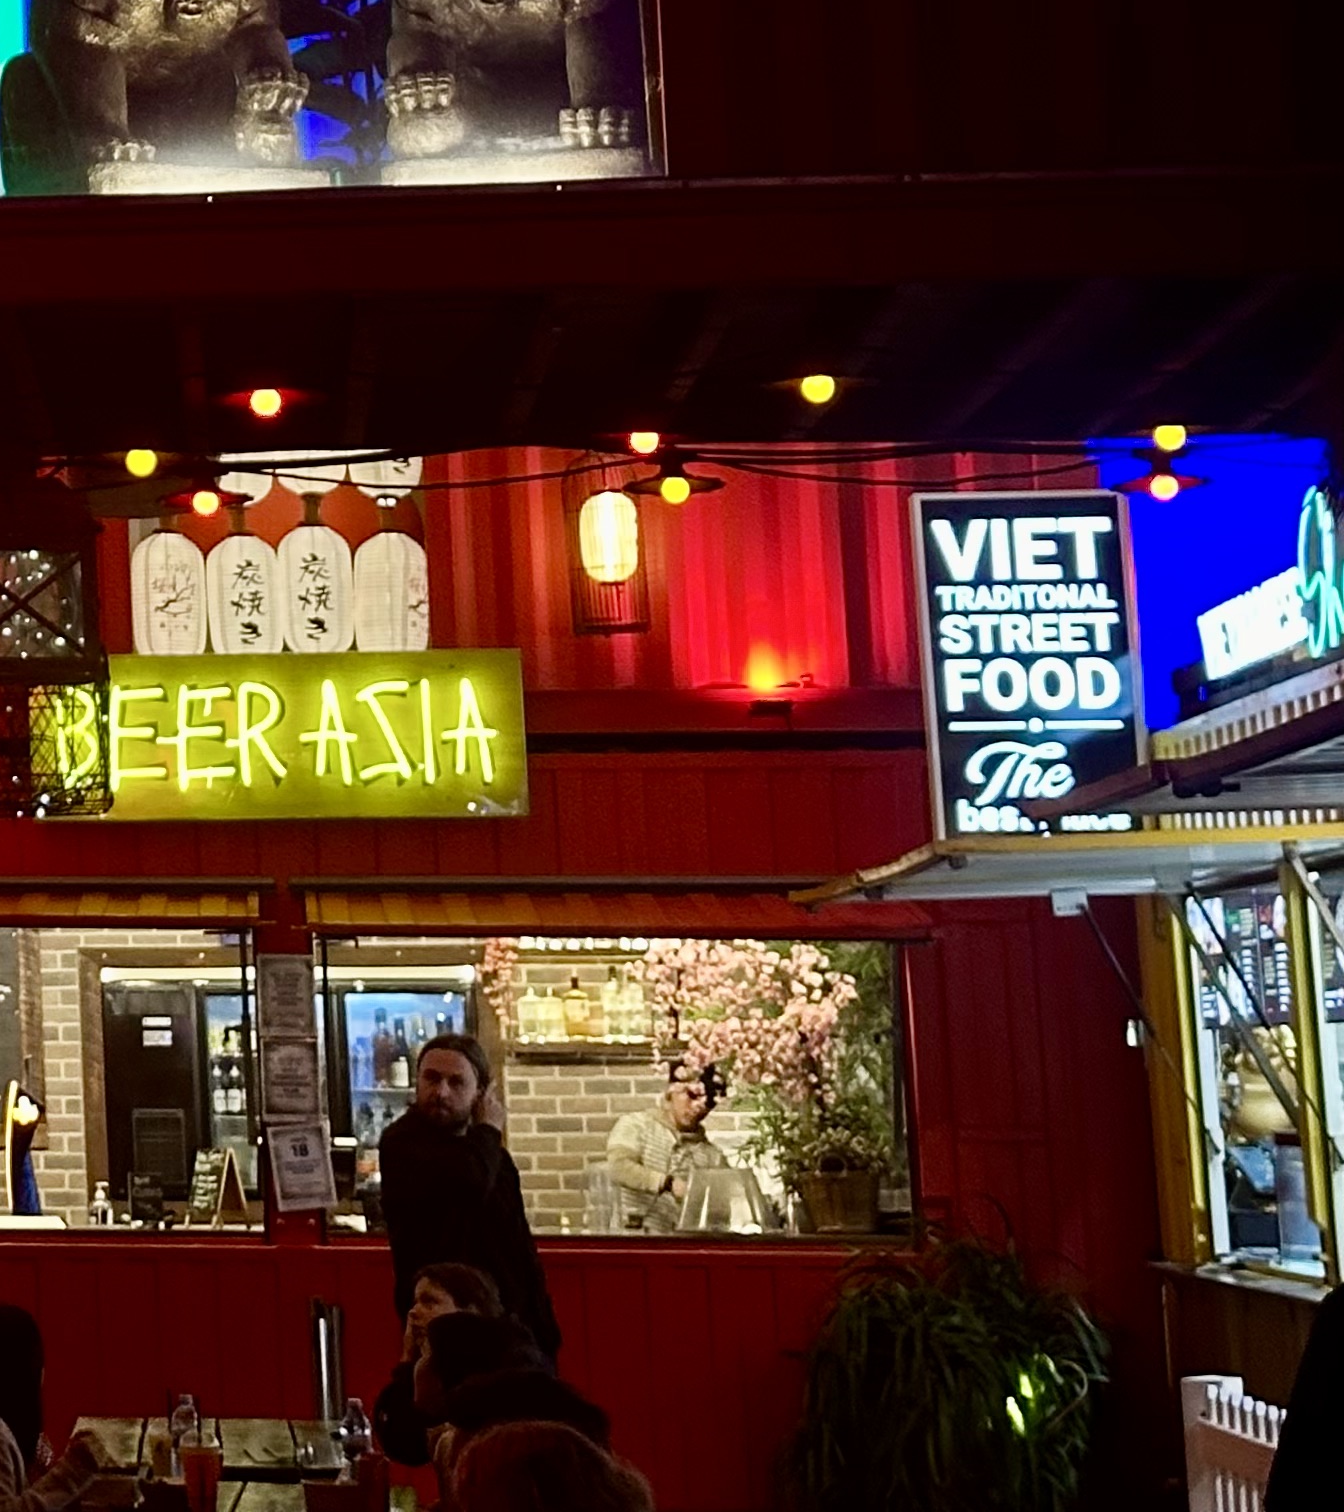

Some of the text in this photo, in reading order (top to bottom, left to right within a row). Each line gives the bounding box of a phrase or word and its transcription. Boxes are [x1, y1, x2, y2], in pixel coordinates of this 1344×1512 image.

[930, 515, 1113, 582] VIET
[934, 583, 1119, 612] TRADITONAL
[938, 611, 1120, 655] STREET
[943, 655, 1122, 713] FOOD
[55, 678, 289, 792] BEER
[964, 740, 1076, 807] The
